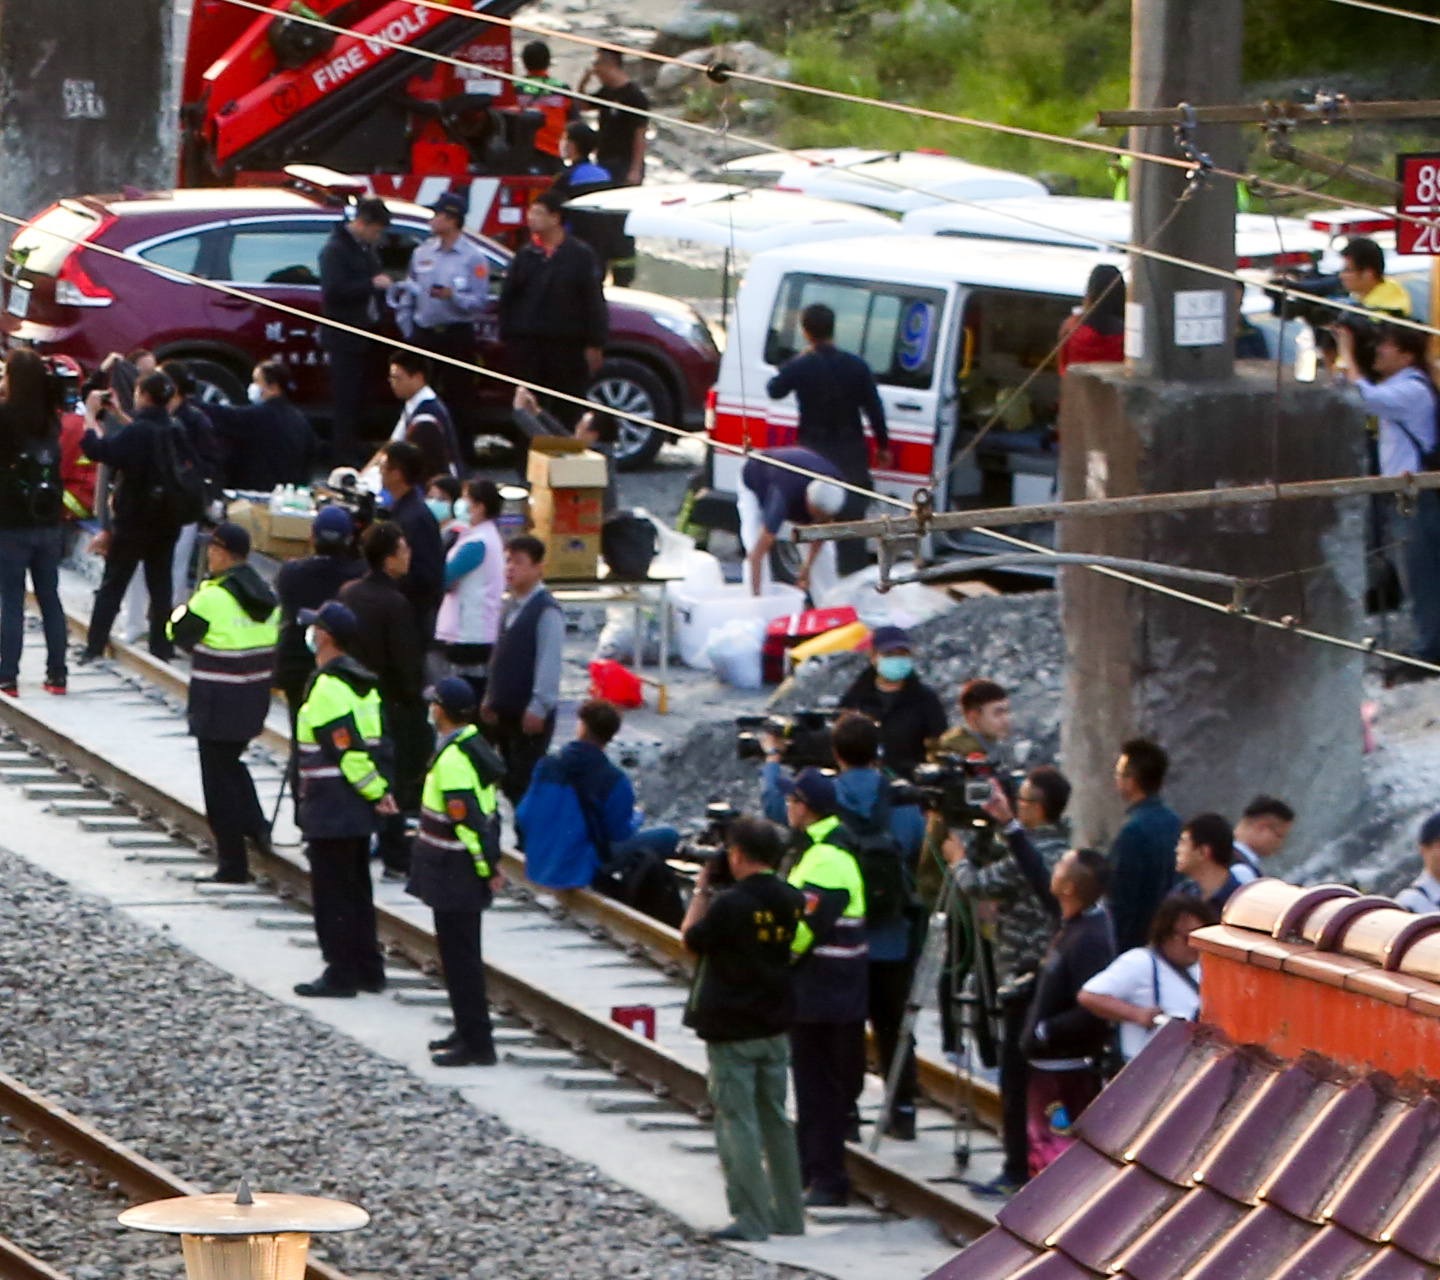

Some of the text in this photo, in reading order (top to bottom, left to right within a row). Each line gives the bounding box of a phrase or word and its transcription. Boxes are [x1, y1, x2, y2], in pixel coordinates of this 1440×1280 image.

[312, 5, 429, 92] FIRE WOLF
[1416, 164, 1440, 204] 8
[899, 301, 931, 370] 9
